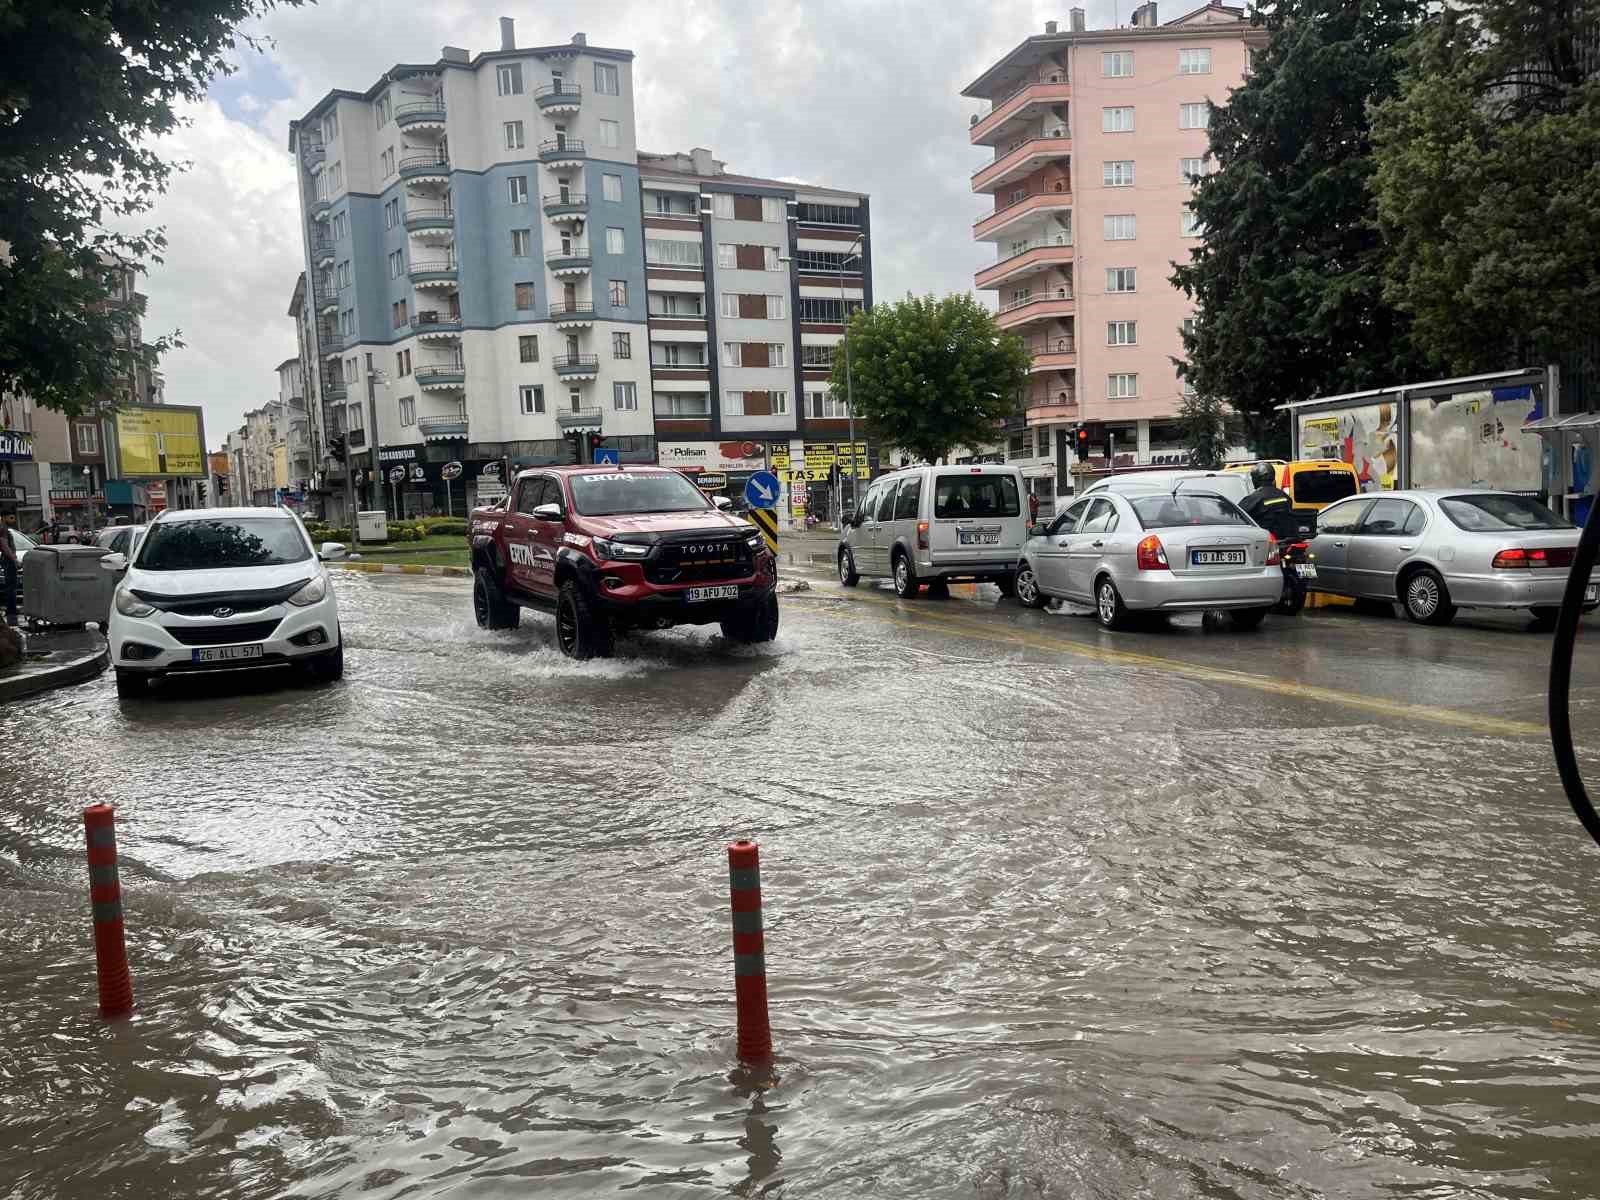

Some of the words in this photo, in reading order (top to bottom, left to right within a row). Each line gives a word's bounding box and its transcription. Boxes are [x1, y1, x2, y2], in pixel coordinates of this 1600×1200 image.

[674, 447, 706, 457] Polisan
[681, 544, 729, 554] TOYOTA
[1228, 552, 1242, 561] 991
[689, 588, 700, 599] 19
[703, 588, 720, 599] AFU
[721, 586, 737, 597] 702
